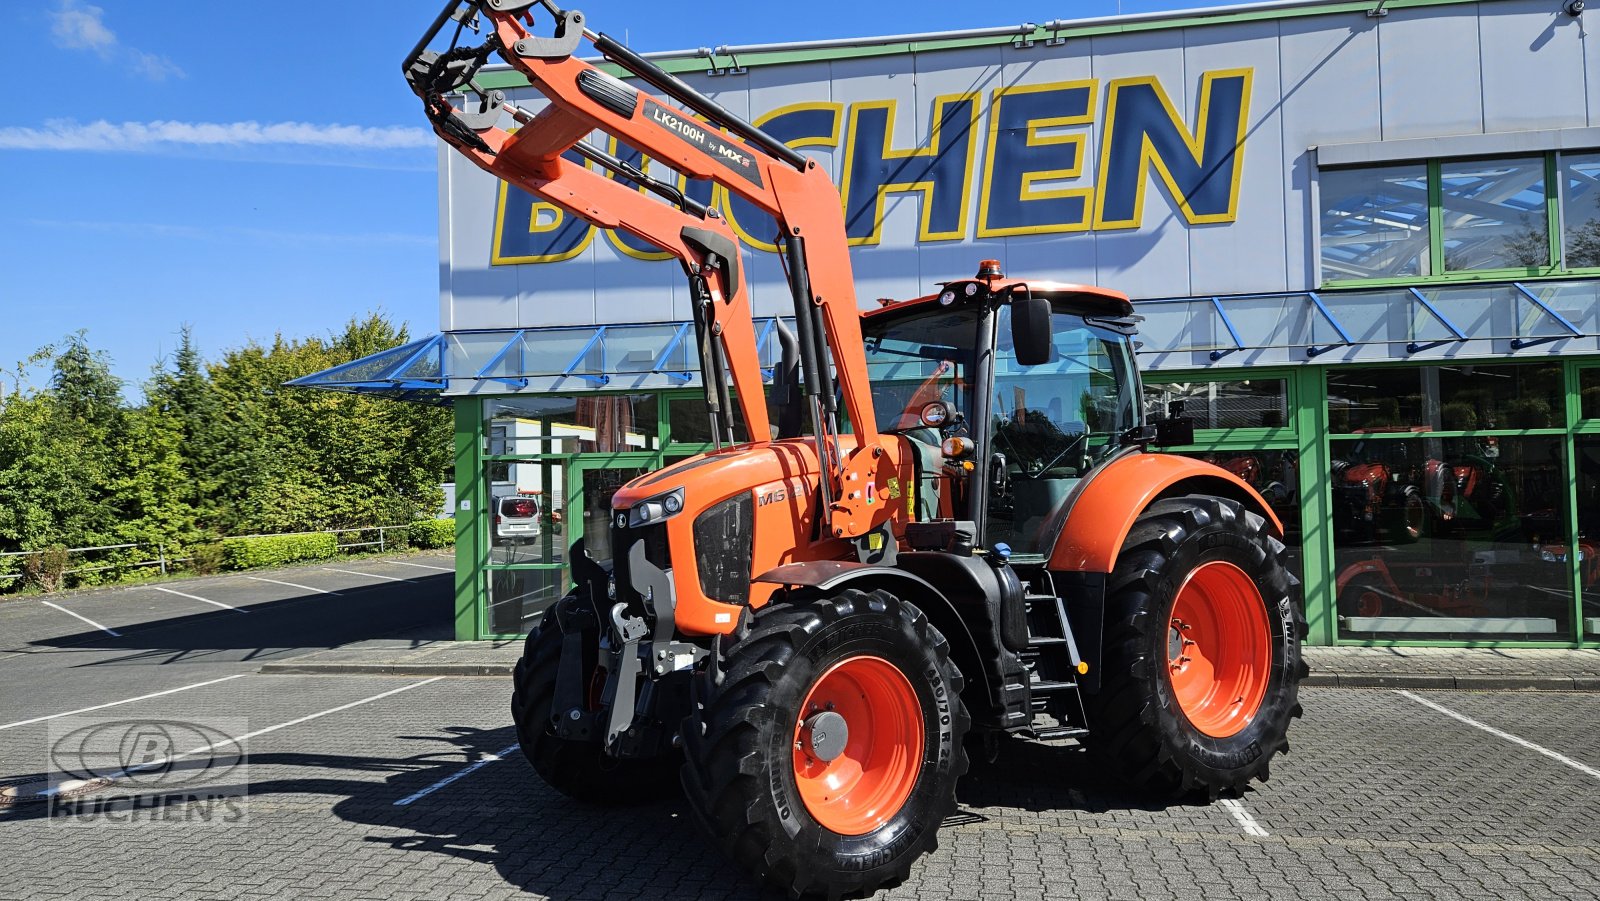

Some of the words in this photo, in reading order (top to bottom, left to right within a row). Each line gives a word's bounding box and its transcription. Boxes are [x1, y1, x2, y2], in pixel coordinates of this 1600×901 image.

[653, 108, 705, 144] LK2100H
[708, 142, 717, 151] by
[718, 144, 742, 164] MX
[927, 669, 950, 726] 480/70
[941, 731, 951, 743] R
[939, 748, 951, 771] 28
